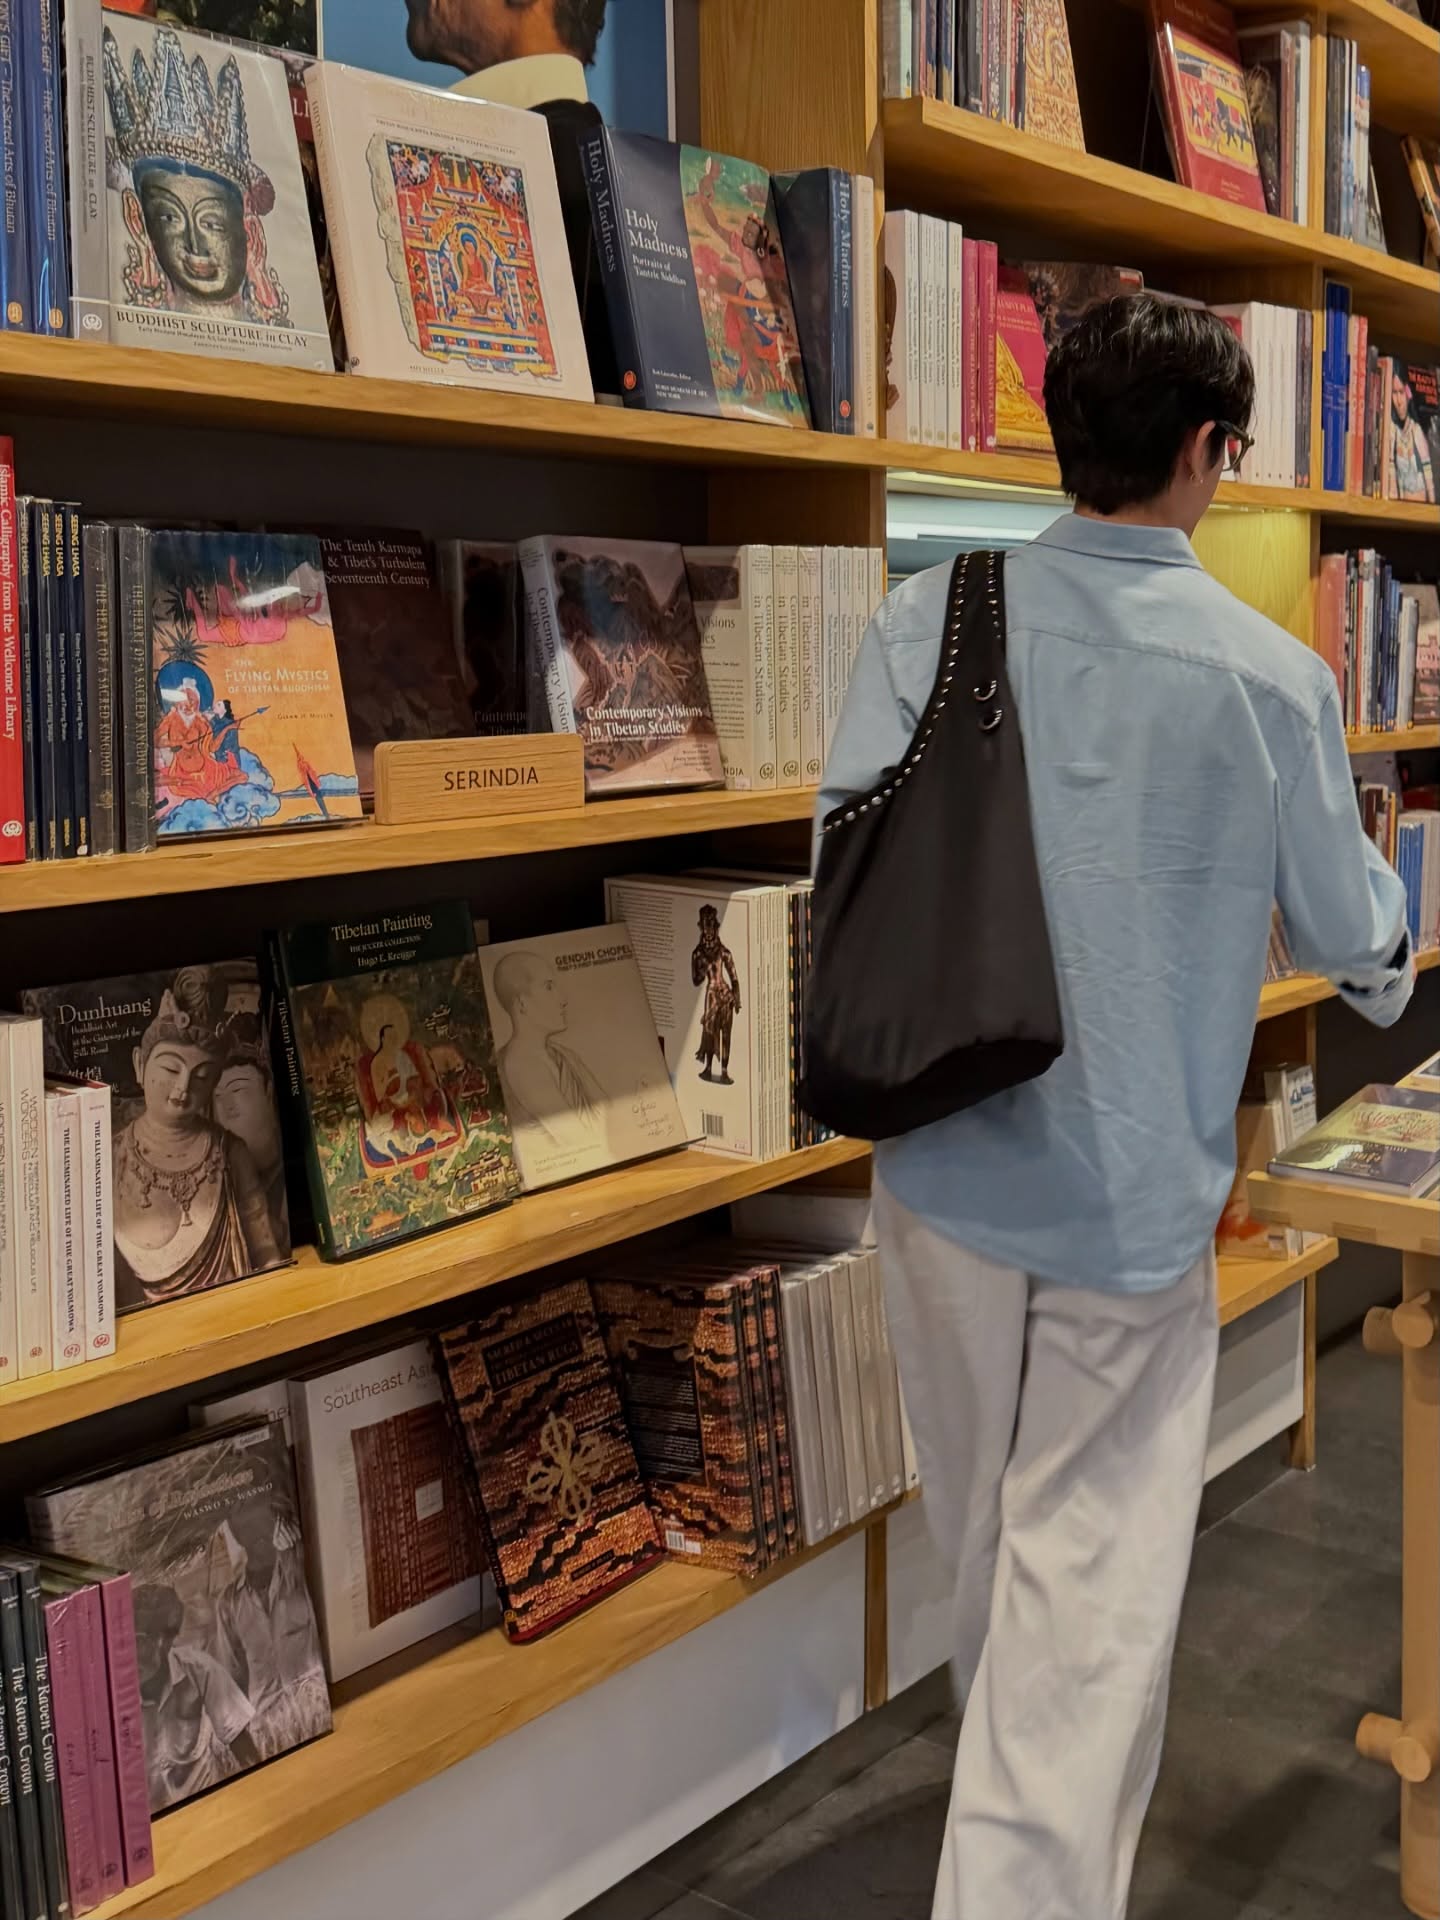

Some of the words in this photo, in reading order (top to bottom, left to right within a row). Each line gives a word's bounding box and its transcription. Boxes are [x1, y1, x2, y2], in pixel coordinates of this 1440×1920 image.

[2, 79, 12, 102] The
[3, 103, 14, 145] Sacred
[5, 148, 14, 172] Arts
[46, 157, 56, 181] Arts
[5, 175, 16, 188] of
[46, 183, 56, 196] of
[6, 190, 16, 233] Bhutan
[89, 192, 98, 219] CLAY
[587, 138, 602, 186] Holy
[596, 189, 616, 272] Madness
[839, 179, 850, 223] Holy
[47, 198, 57, 241] Bhutan
[624, 208, 659, 232] Holy
[628, 228, 688, 260] Madness
[632, 254, 658, 272] Portraits
[662, 262, 672, 271] of
[634, 265, 660, 281] Tantric
[840, 230, 851, 308] Madness
[116, 310, 187, 331] BUDDHIST
[190, 320, 263, 342] SCULPTURE
[266, 332, 276, 342] in
[278, 334, 308, 348] CLAY
[0, 464, 10, 508] Islamic
[0, 510, 12, 579] Calligraphy
[42, 512, 50, 546] SEEING
[55, 513, 64, 546] SEEING
[71, 514, 80, 546] SEEING
[42, 547, 51, 576] LHASA
[56, 547, 64, 576] LHASA
[72, 548, 80, 576] LHASA
[320, 538, 342, 552] The
[344, 539, 376, 553] Tenth
[379, 540, 422, 558] Karmapa
[327, 556, 340, 568] &
[341, 555, 377, 569] Tibet's
[378, 556, 427, 571] Turbulent
[2, 582, 12, 610] from
[96, 583, 106, 604] THE
[133, 584, 143, 604] THE
[326, 571, 389, 586] Seventeenth
[390, 572, 432, 589] Century
[754, 595, 762, 608] in
[778, 595, 786, 608] in
[802, 595, 810, 608] in
[4, 613, 13, 632] the
[97, 606, 108, 642] HEART
[134, 607, 144, 645] HEART
[754, 614, 764, 662] Tibetan
[778, 614, 788, 662] Tibetan
[802, 614, 812, 661] Tibetan
[98, 648, 108, 664] OF
[134, 648, 144, 664] OF
[766, 595, 774, 690] Contemporary
[790, 595, 798, 688] Contemporary
[814, 596, 822, 688] Contemporary
[4, 634, 16, 694] Wellcome
[98, 666, 108, 678] A
[224, 668, 272, 682] FLYING
[276, 668, 328, 681] MYSTICS
[537, 586, 561, 690] Contemporary
[556, 691, 571, 733] Vision
[98, 677, 110, 718] SACRED
[135, 677, 146, 718] SACRED
[228, 686, 239, 694] OF
[243, 684, 279, 694] TIBETAN
[754, 666, 766, 716] Studies
[778, 665, 790, 713] Studies
[802, 664, 813, 712] Studies
[3, 696, 16, 740] Library
[586, 706, 664, 722] Contemporary
[666, 704, 702, 718] Visions
[589, 723, 601, 736] in
[604, 722, 646, 737] Tibetan
[648, 720, 686, 735] Studies
[100, 722, 112, 776] KINGDOM
[136, 722, 146, 775] KINGDOM
[443, 766, 539, 792] SERINDIA
[331, 923, 380, 940] Tibetan
[382, 914, 433, 933] Painting
[358, 956, 378, 968] Hugo
[555, 950, 595, 966] GENDUN
[597, 944, 632, 958] CHOPEL
[58, 996, 152, 1024] Dunhuang
[105, 1020, 118, 1030] Art
[278, 997, 292, 1045] Tibetan
[284, 1046, 300, 1097] Painting
[21, 1088, 31, 1160] WONDERS
[30, 1096, 39, 1158] WOODEN
[65, 1228, 72, 1238] OF
[96, 1219, 102, 1230] OF
[322, 1372, 404, 1413] Southeast
[184, 1501, 221, 1520] WASWO
[237, 1482, 273, 1500] WASWO
[10, 1662, 25, 1692] The
[35, 1654, 48, 1680] The
[14, 1696, 28, 1742] Raven
[38, 1684, 52, 1730] Raven
[17, 1746, 34, 1794] Crown
[41, 1732, 56, 1782] Crown
[0, 1754, 11, 1805] Crown
